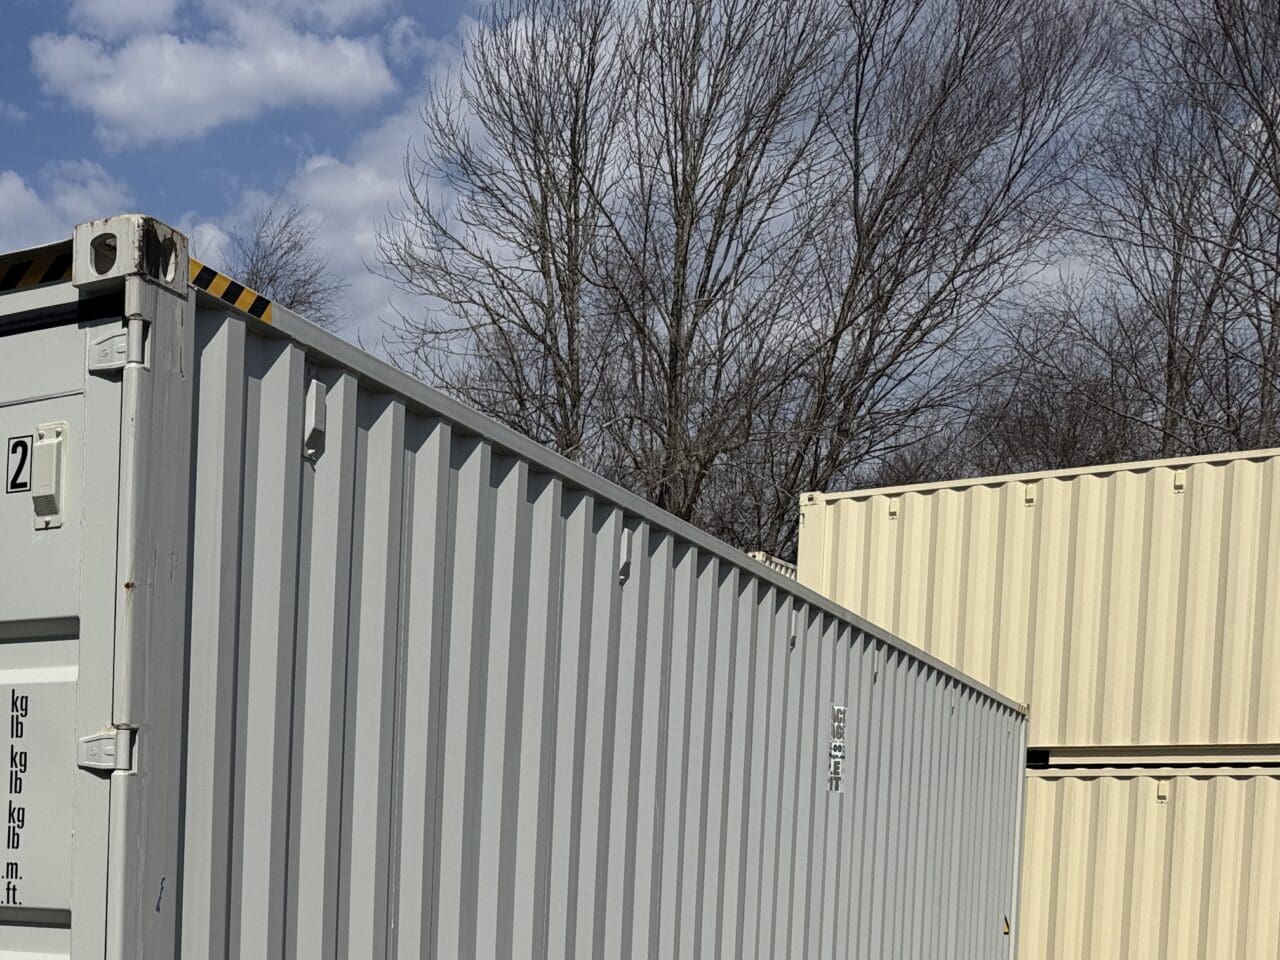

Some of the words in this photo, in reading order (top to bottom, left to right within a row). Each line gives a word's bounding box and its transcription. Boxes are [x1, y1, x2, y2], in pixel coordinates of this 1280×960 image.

[10, 439, 28, 490] 2
[11, 688, 29, 718] kg
[10, 714, 24, 739] lb
[9, 744, 27, 774] kg
[9, 770, 22, 794] lb
[8, 800, 26, 829] kg
[7, 825, 20, 850] lb
